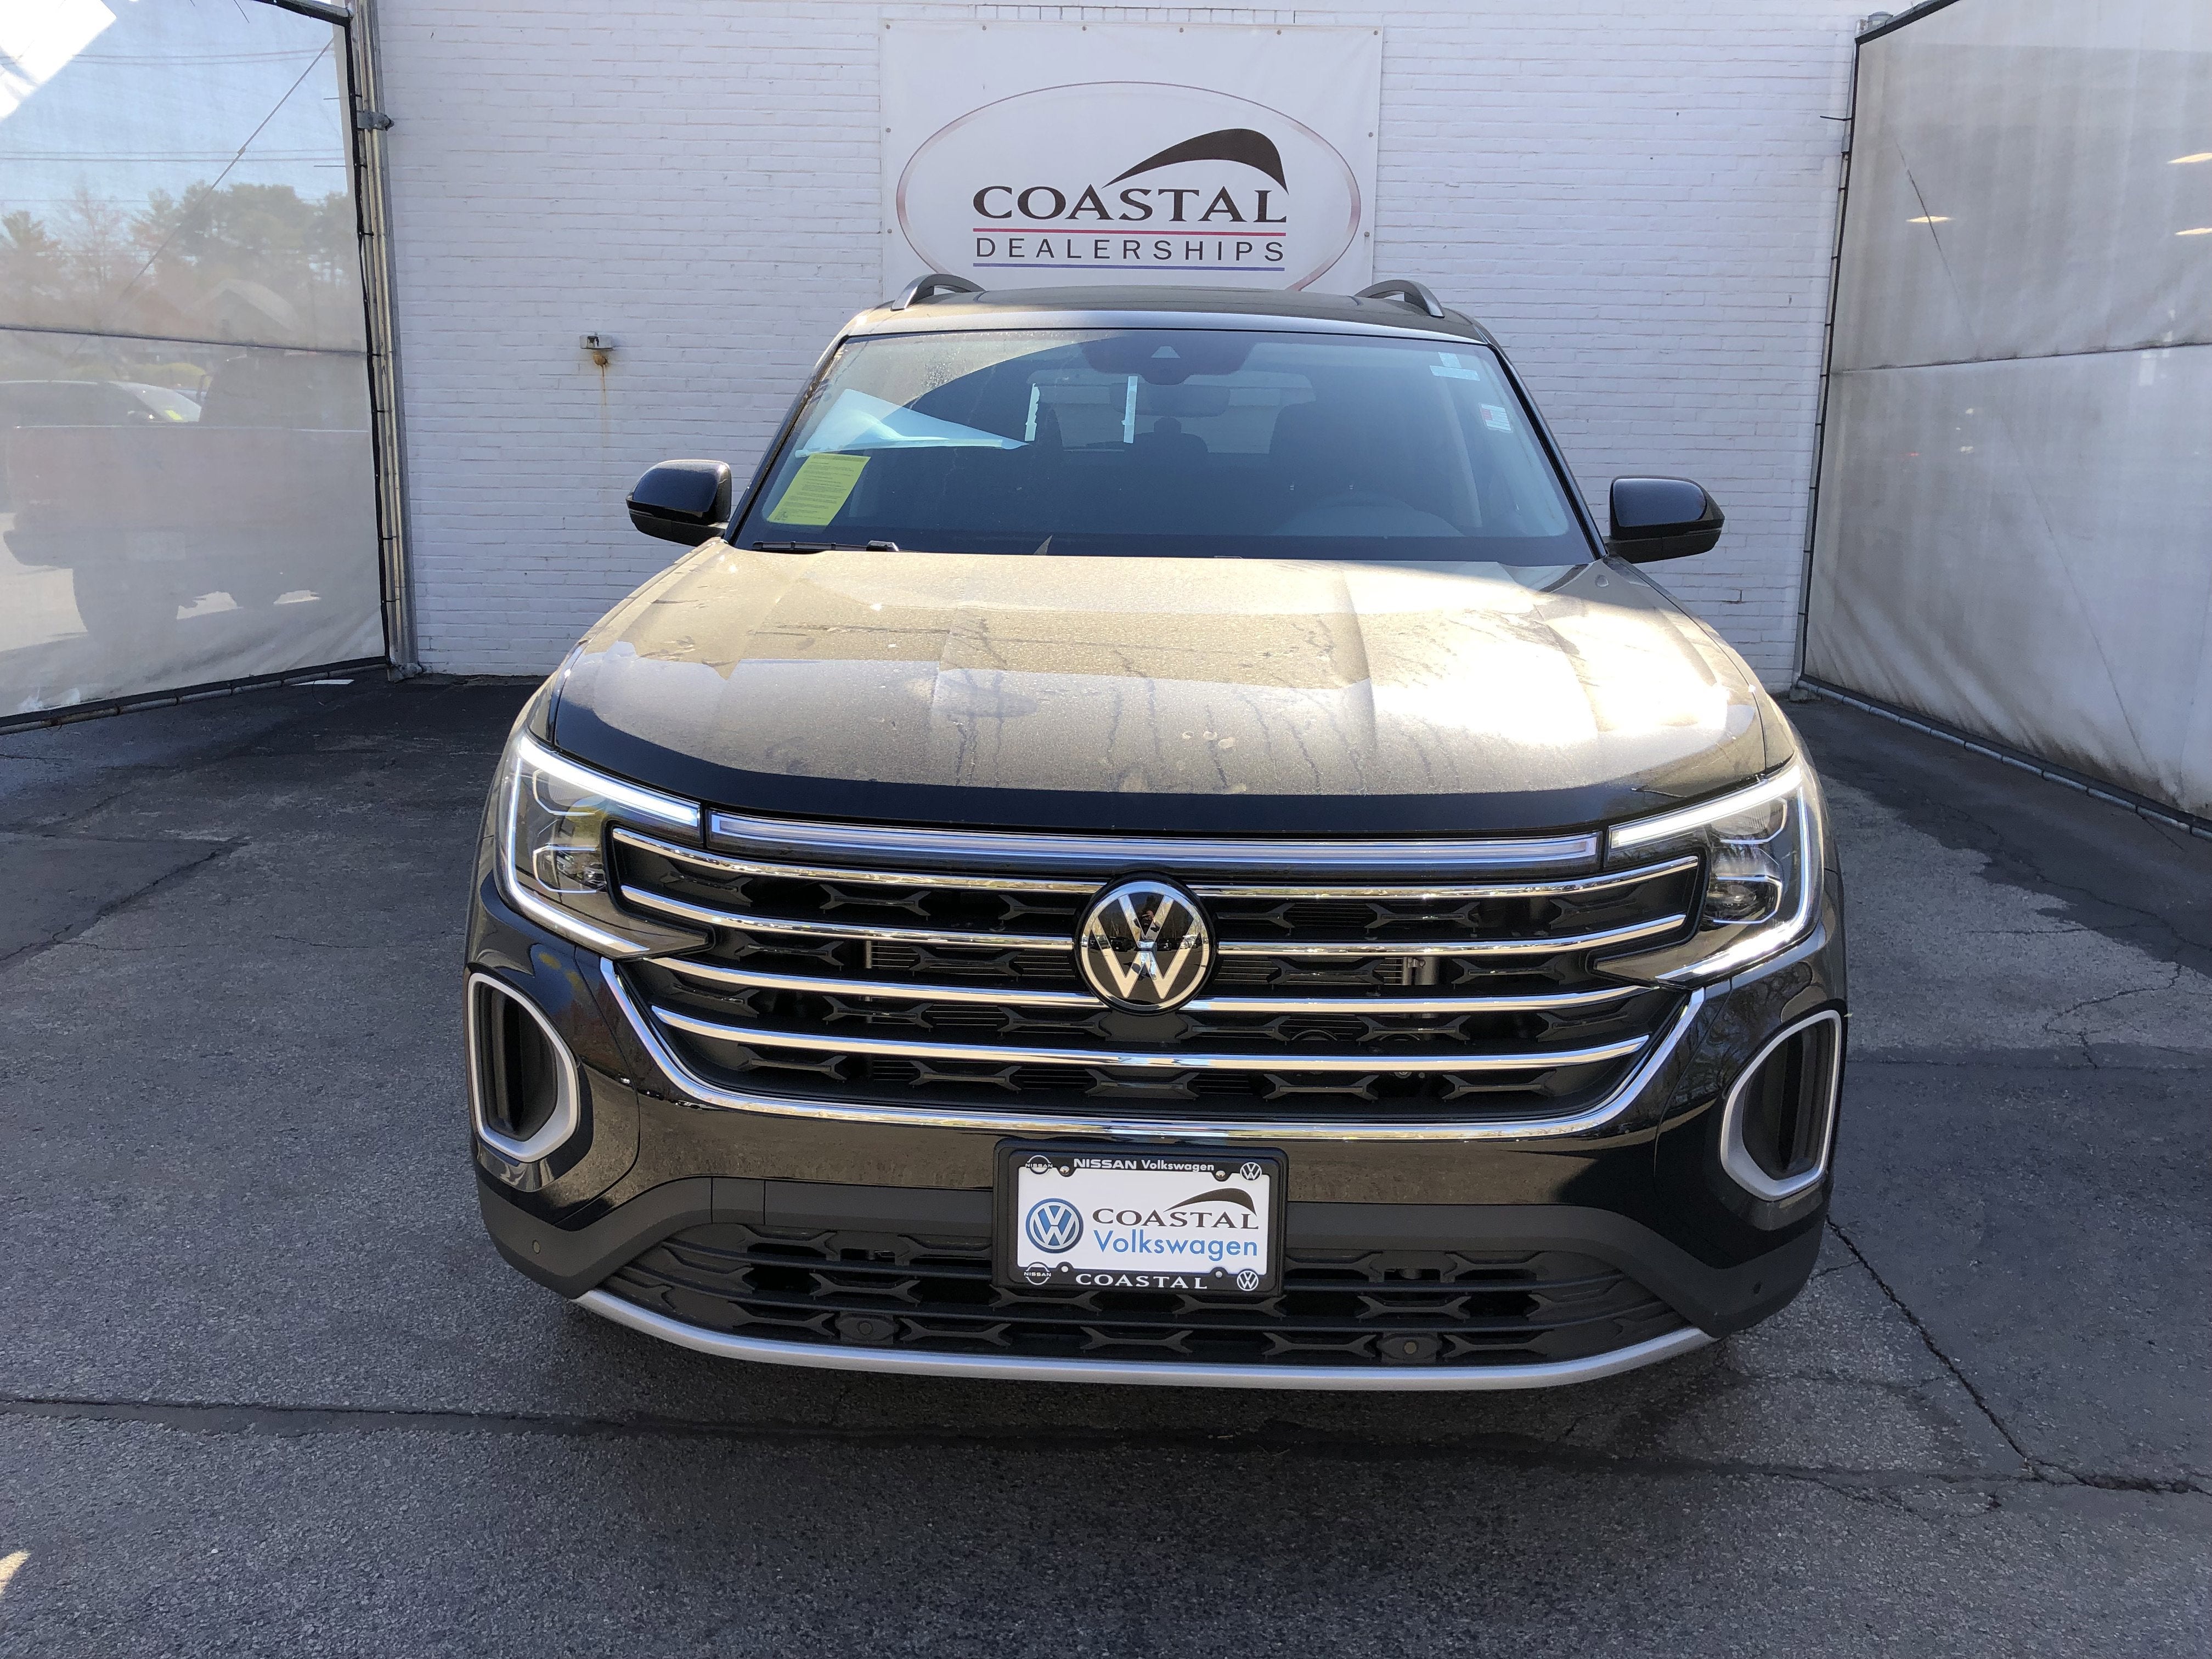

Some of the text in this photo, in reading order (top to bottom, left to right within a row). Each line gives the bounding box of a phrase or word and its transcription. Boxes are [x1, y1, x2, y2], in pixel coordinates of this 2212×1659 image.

[973, 184, 1288, 224] COASTAL
[977, 237, 1284, 262] DEALERSHIPS
[1074, 1158, 1215, 1172] NISSAN Volkswagen
[1092, 1208, 1259, 1229] COASTAL
[1093, 1228, 1257, 1261] Volkswagen
[1075, 1273, 1207, 1289] COASTAL
